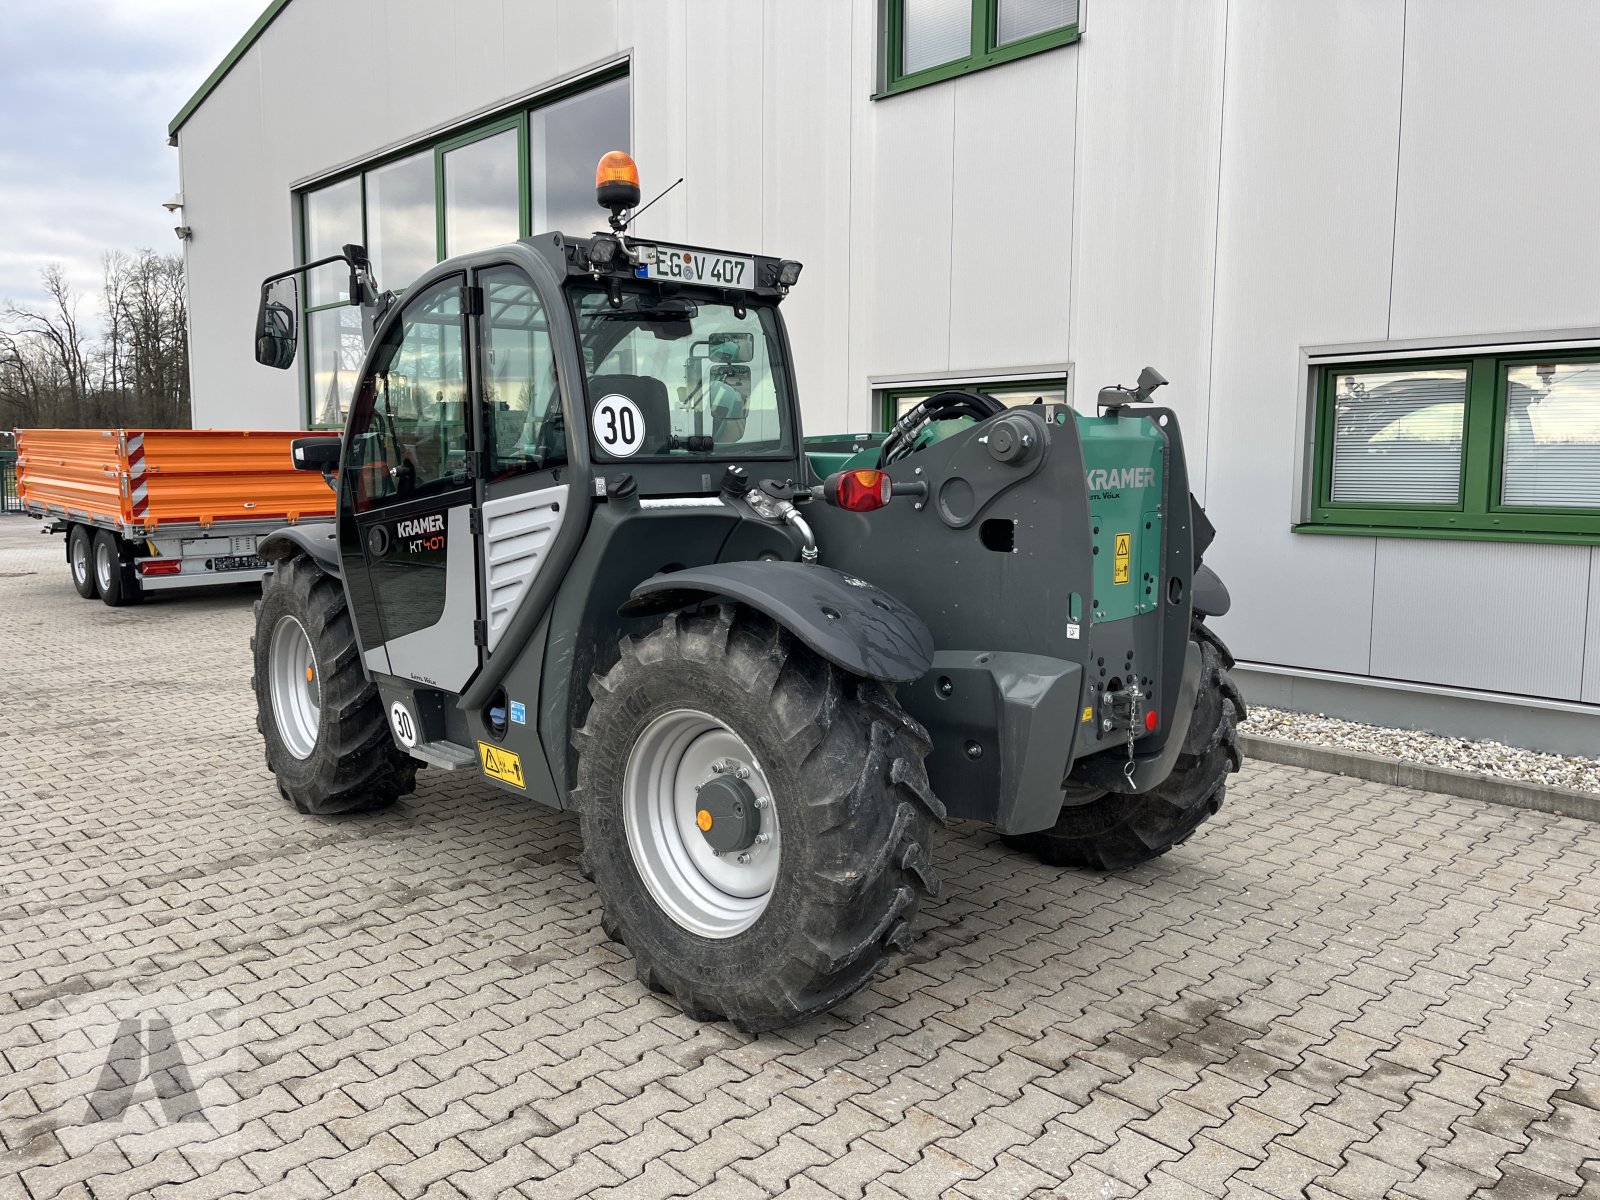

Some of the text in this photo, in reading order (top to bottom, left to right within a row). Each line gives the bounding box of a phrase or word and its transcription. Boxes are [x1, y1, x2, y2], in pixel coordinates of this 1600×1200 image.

[656, 251, 746, 285] EG V 407
[601, 405, 636, 445] 30
[1086, 467, 1156, 491] KRAMER
[396, 514, 445, 538] KRAMER
[394, 708, 414, 741] 30
